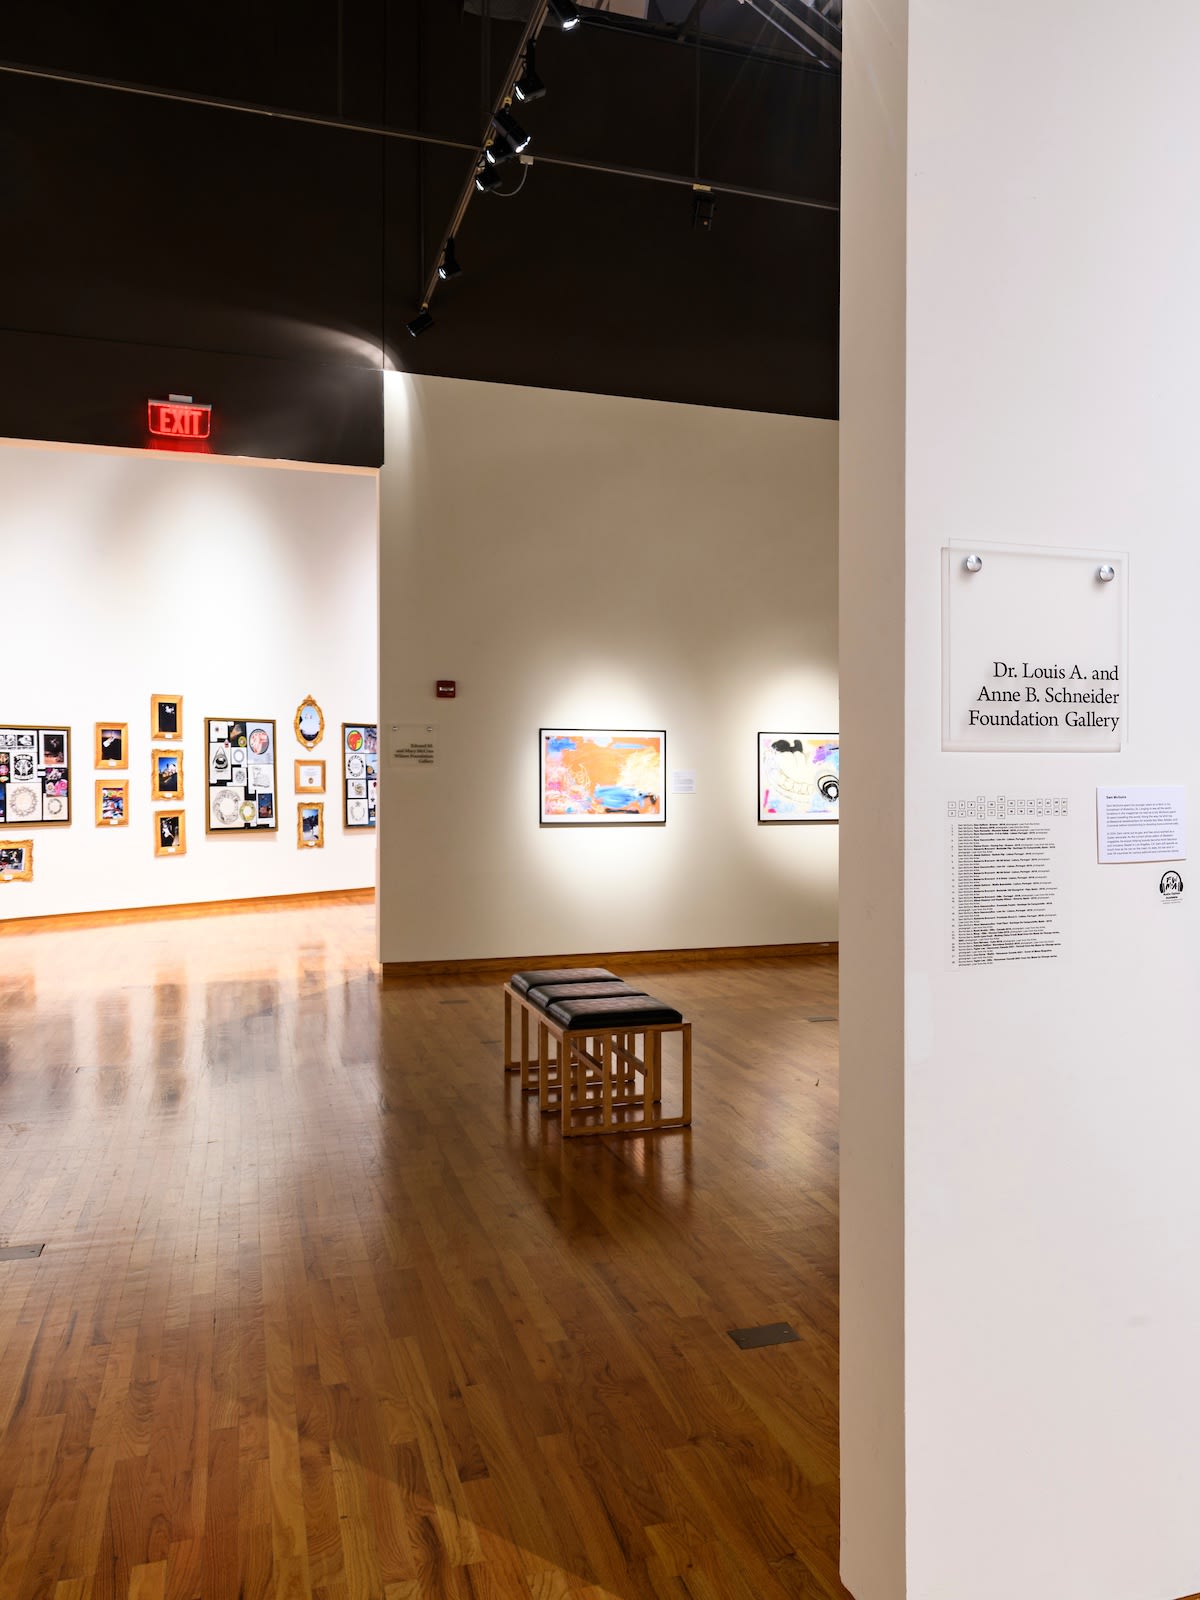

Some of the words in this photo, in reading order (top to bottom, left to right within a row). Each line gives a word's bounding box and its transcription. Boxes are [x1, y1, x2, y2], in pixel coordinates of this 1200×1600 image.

[159, 407, 202, 435] EXIT
[992, 661, 1017, 679] Dr.
[1022, 662, 1065, 680] Louis
[1068, 664, 1087, 680] A.
[1091, 665, 1119, 681] and
[976, 686, 1021, 702] Anne
[1025, 687, 1040, 703] B.
[1044, 687, 1120, 705] Schneider
[968, 709, 1058, 727] Foundation
[1064, 711, 1120, 732] Gallery
